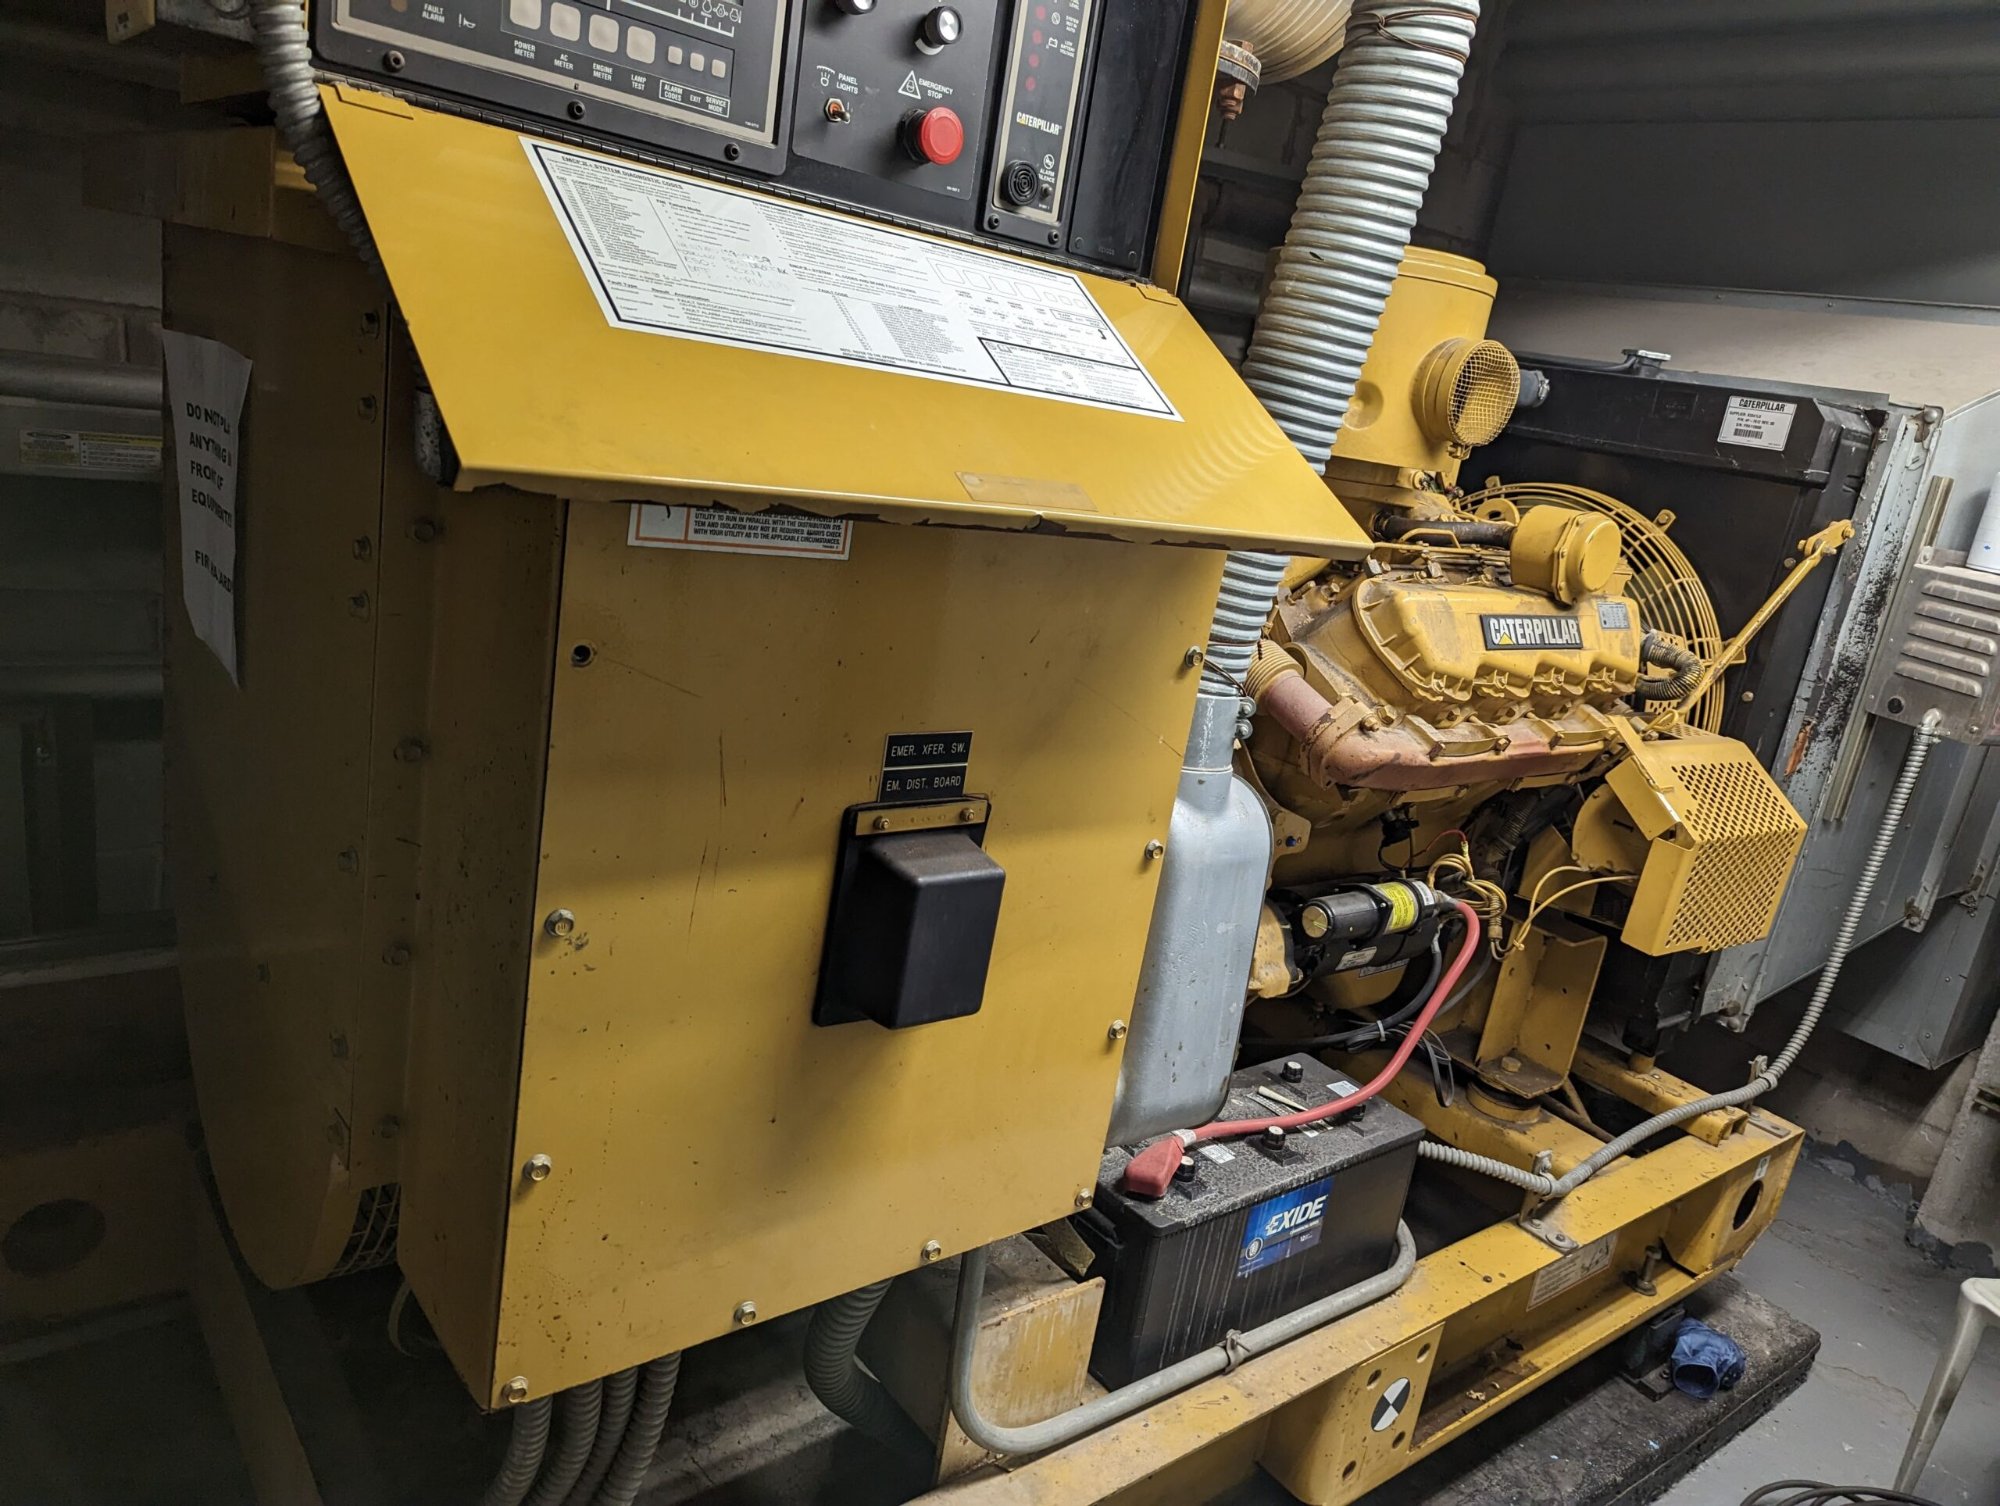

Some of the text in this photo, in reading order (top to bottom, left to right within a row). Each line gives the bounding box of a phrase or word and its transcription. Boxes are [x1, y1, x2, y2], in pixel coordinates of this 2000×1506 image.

[424, 3, 444, 15] FAULT
[422, 11, 445, 24] ALARM
[514, 40, 536, 52] POWER
[514, 48, 535, 60] METER
[560, 53, 569, 62] AC
[554, 59, 573, 70] METER
[592, 62, 613, 74] ENGINE
[592, 71, 612, 82] METER
[631, 74, 646, 84] LAMP
[838, 73, 858, 86] PANEL
[632, 81, 645, 91] TEST
[664, 84, 683, 95] ALARM
[836, 82, 859, 95] LIGHTS
[918, 78, 954, 95] EMERGENCY
[664, 91, 682, 102] CODES
[689, 94, 702, 104] EXIT
[927, 90, 943, 100] STOP
[706, 95, 727, 108] SERVICE
[708, 103, 723, 114] MODE
[1016, 111, 1060, 136] CATERPILLAR
[186, 402, 201, 420] DO
[1738, 398, 1786, 413] CATERPILLAR
[719, 522, 747, 531] ISOLATION
[745, 516, 770, 524] PARALLEL
[797, 521, 831, 530] DISTRIBUTION
[770, 534, 799, 542] APPLICABLE
[1489, 617, 1580, 645] CATERPILLAR
[891, 742, 967, 757] EMER. XFER. SW.
[886, 775, 961, 791] EM. DIST. BOARD
[1265, 1194, 1328, 1237] EXIDE
